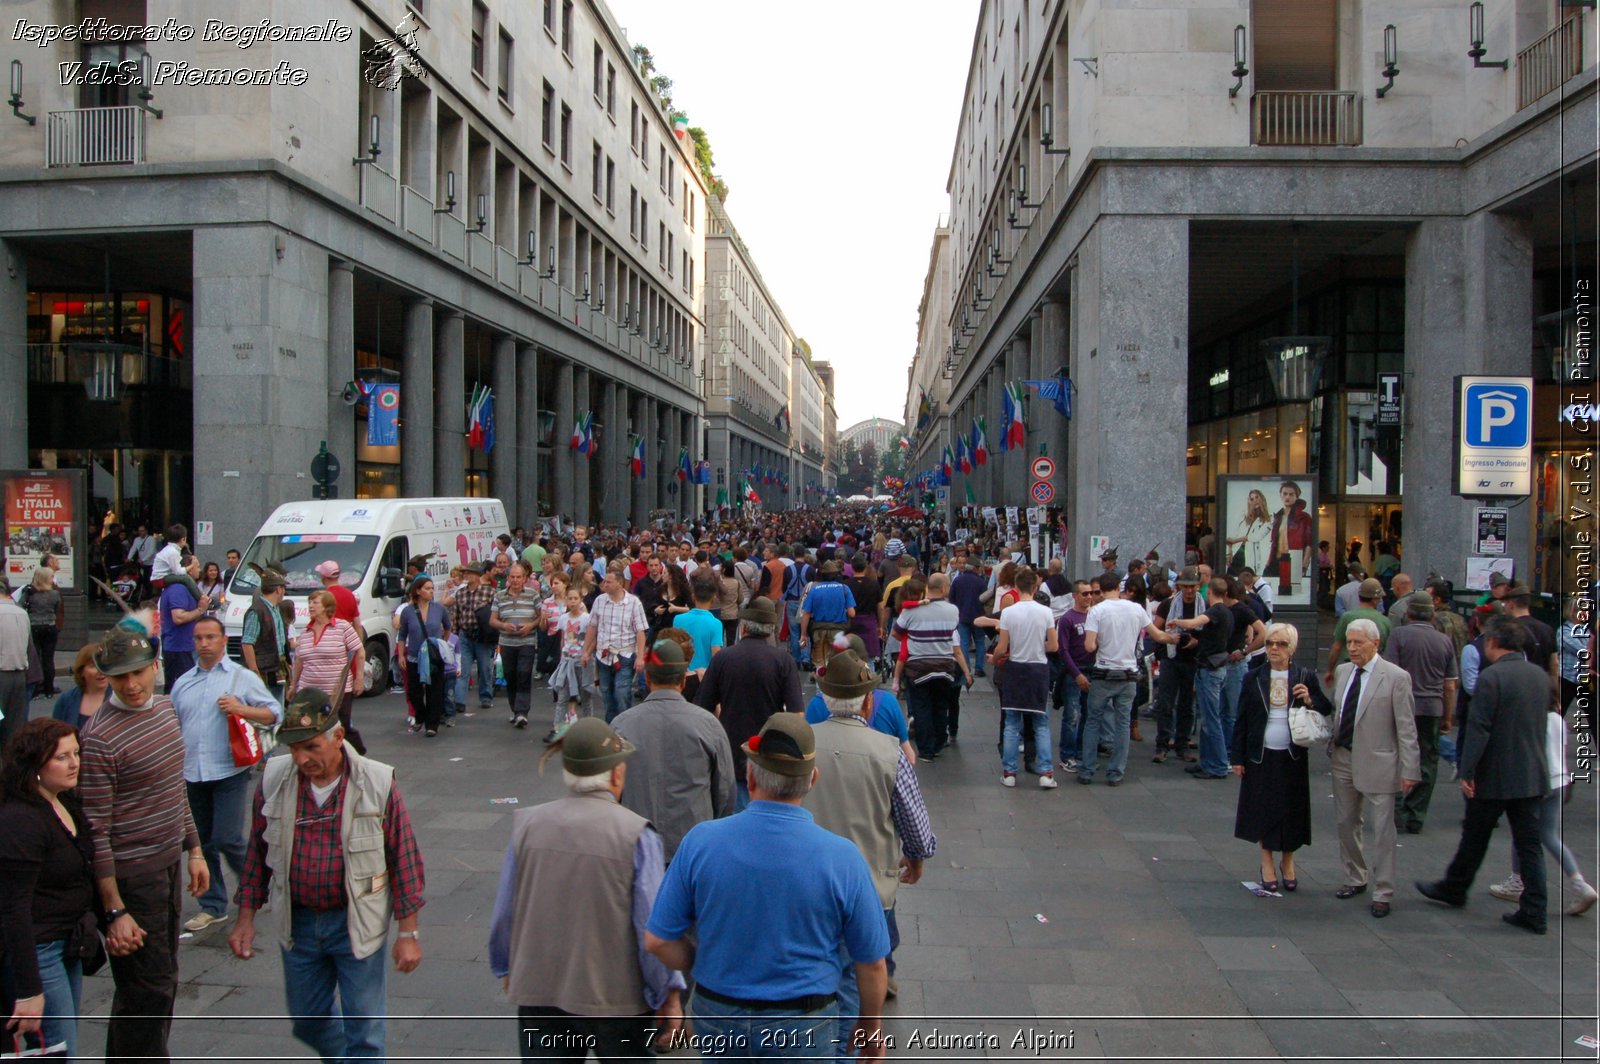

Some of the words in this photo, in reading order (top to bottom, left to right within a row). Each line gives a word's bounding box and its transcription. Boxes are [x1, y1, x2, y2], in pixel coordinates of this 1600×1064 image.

[1382, 376, 1398, 403] T
[1481, 398, 1516, 443] P
[1465, 459, 1494, 468] Ingresso
[1496, 459, 1527, 468] Pedonale
[16, 498, 63, 509] L'ITALIA
[34, 510, 56, 519] QUI
